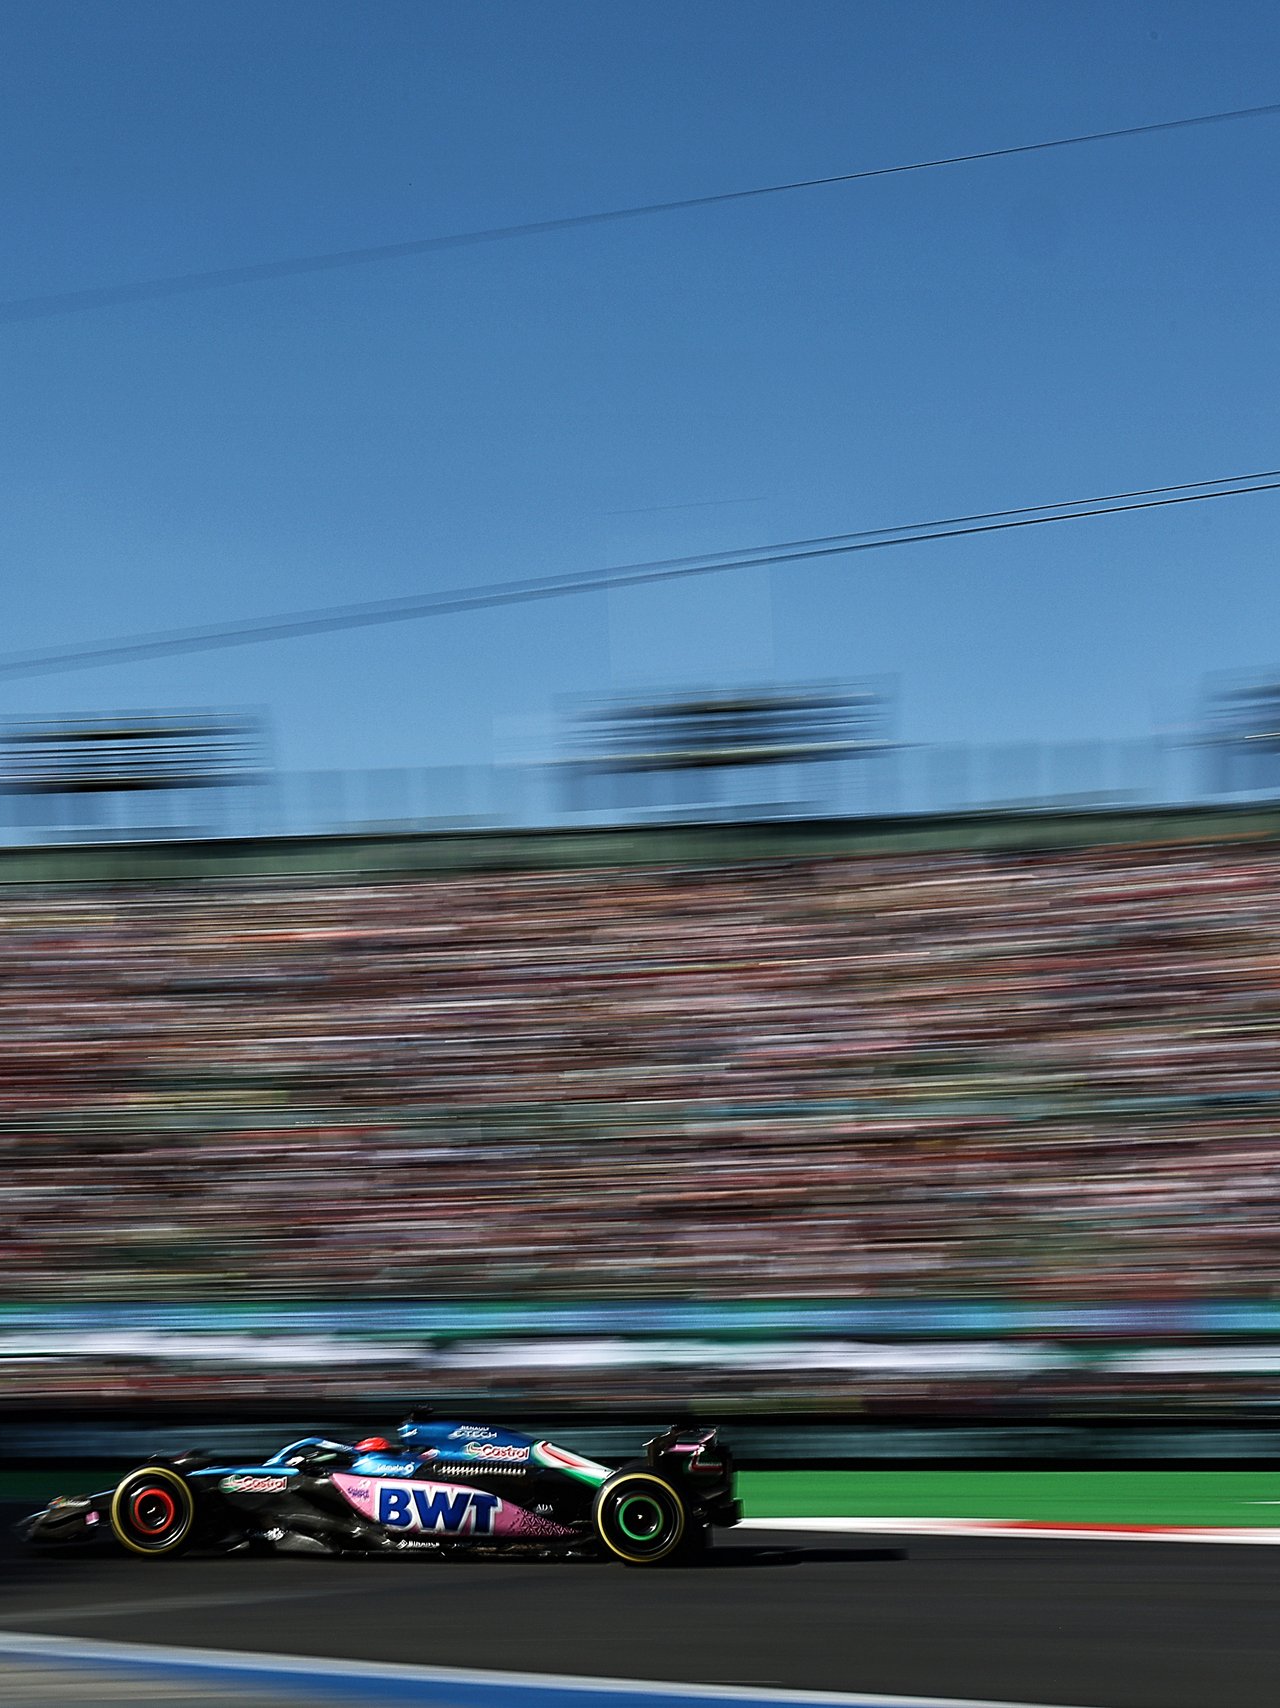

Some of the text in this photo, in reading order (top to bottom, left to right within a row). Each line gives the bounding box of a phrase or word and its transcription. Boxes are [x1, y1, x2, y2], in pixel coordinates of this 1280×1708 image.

[481, 1444, 529, 1458] Castrol
[241, 1476, 287, 1491] Castrol
[378, 1487, 499, 1534] BWT
